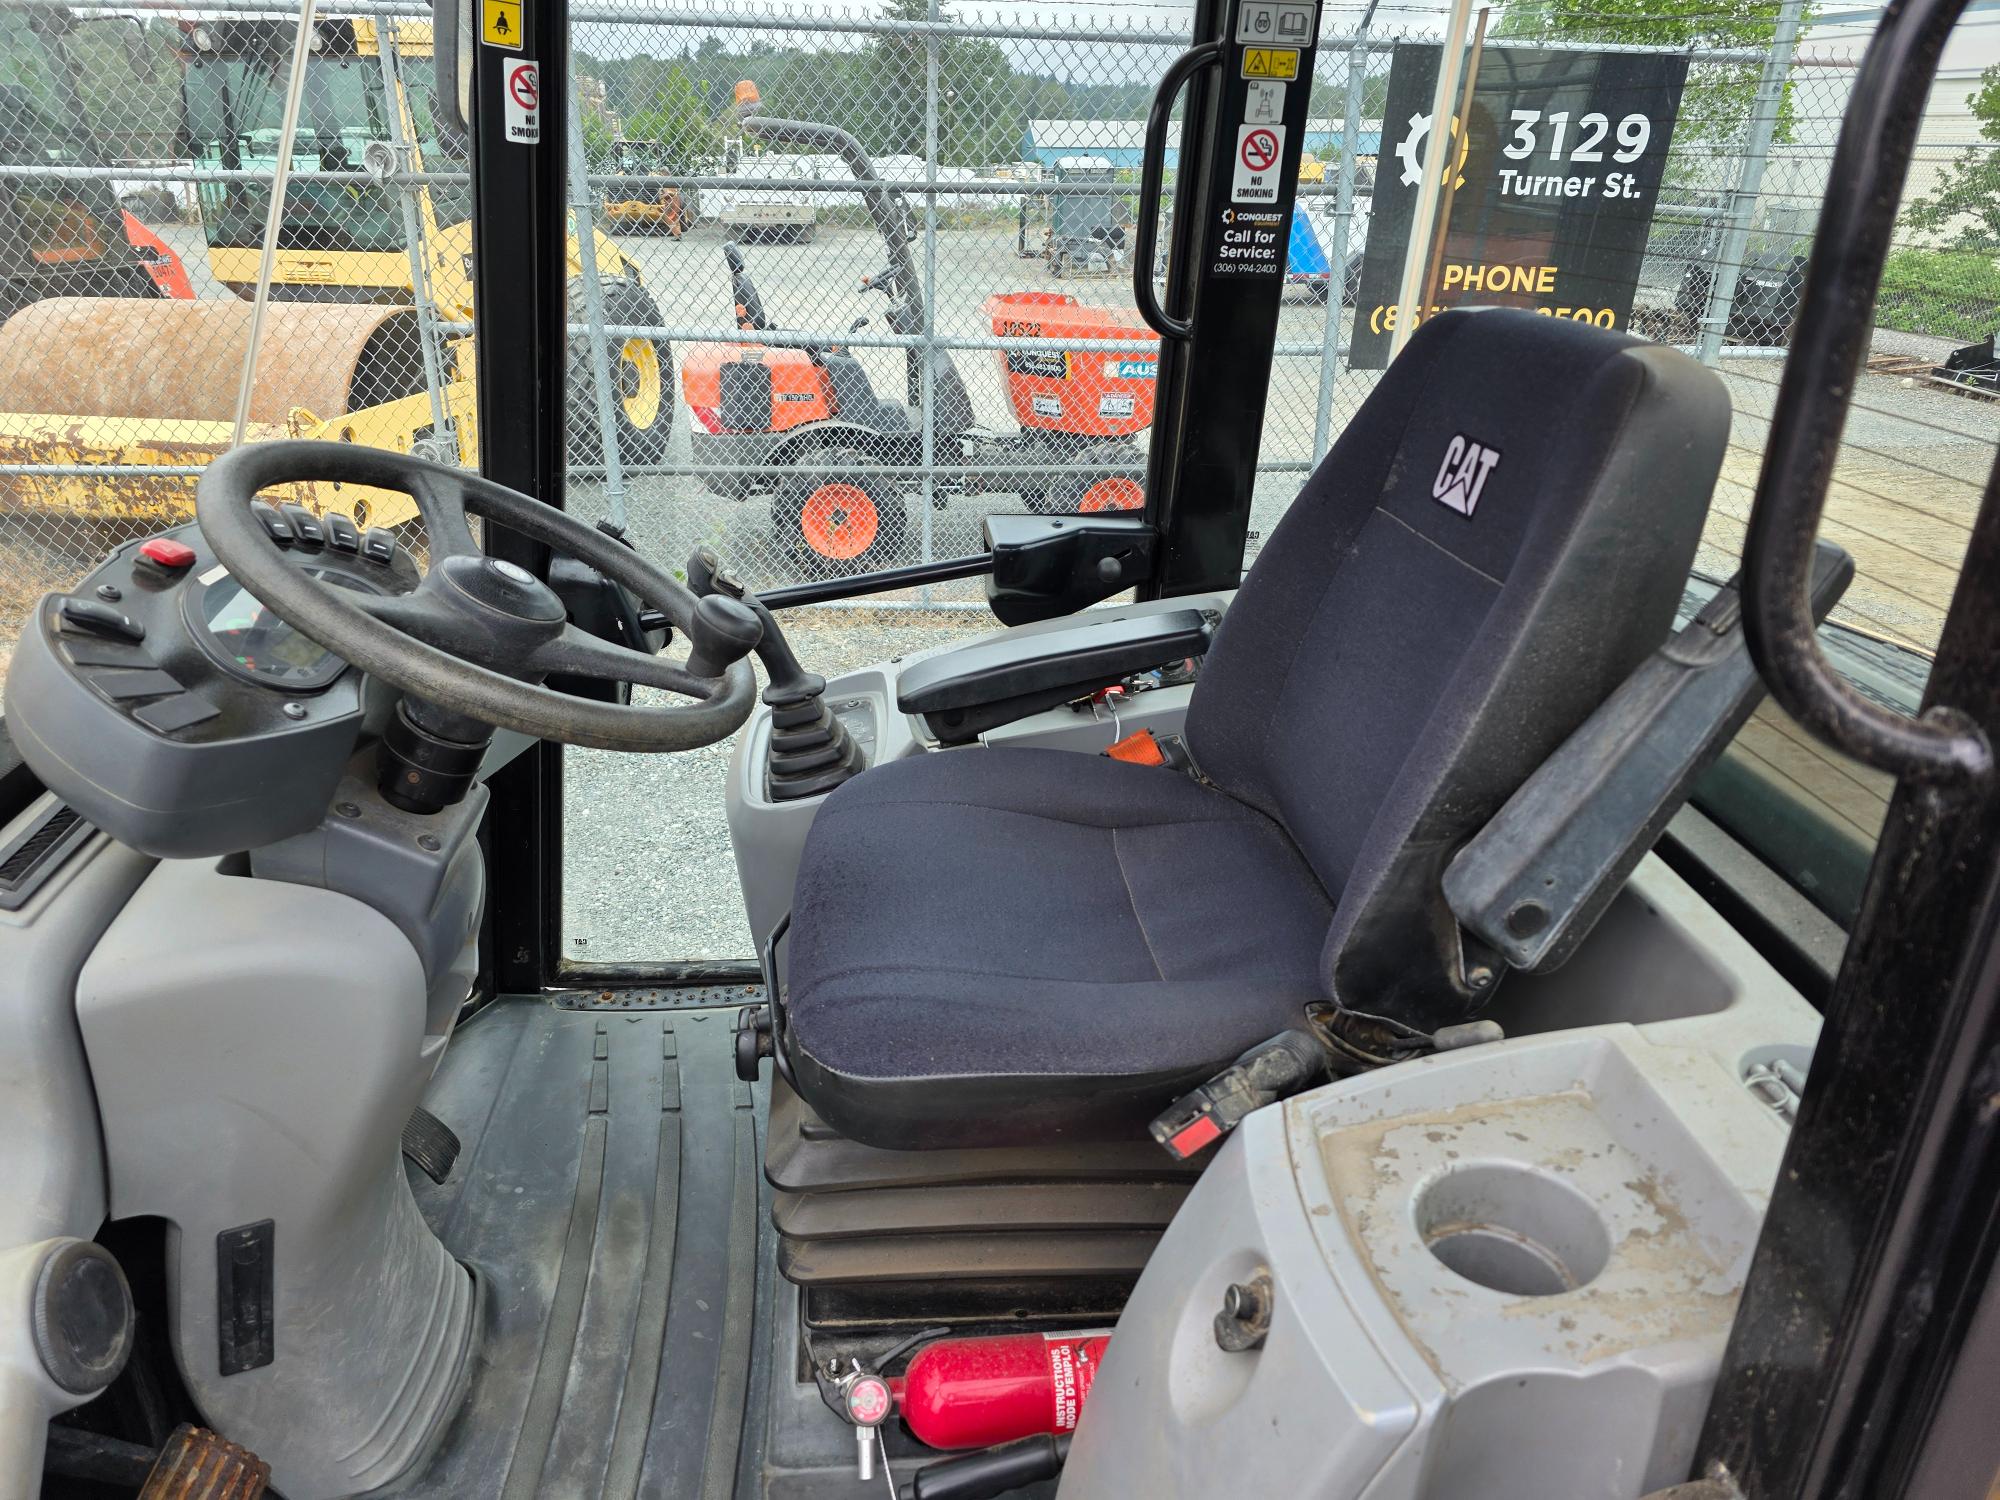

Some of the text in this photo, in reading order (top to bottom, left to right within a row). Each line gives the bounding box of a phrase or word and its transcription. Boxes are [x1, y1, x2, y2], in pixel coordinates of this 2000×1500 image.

[525, 115, 536, 126] NO
[1502, 109, 1651, 164] 3129
[1250, 176, 1263, 186] NO
[1499, 169, 1642, 199] Turner St.
[1236, 188, 1274, 198] SMOKING
[1237, 212, 1283, 222] CONQUEST
[1224, 230, 1275, 243] Call for
[1220, 245, 1275, 259] Service:
[1213, 263, 1277, 273] (306) 994-2400
[1443, 265, 1558, 293] PHONE
[1432, 435, 1500, 516] CAT
[1051, 1348, 1066, 1427] INSTRUCTIONS
[1060, 1345, 1076, 1429] MODE D'EMPLOI
